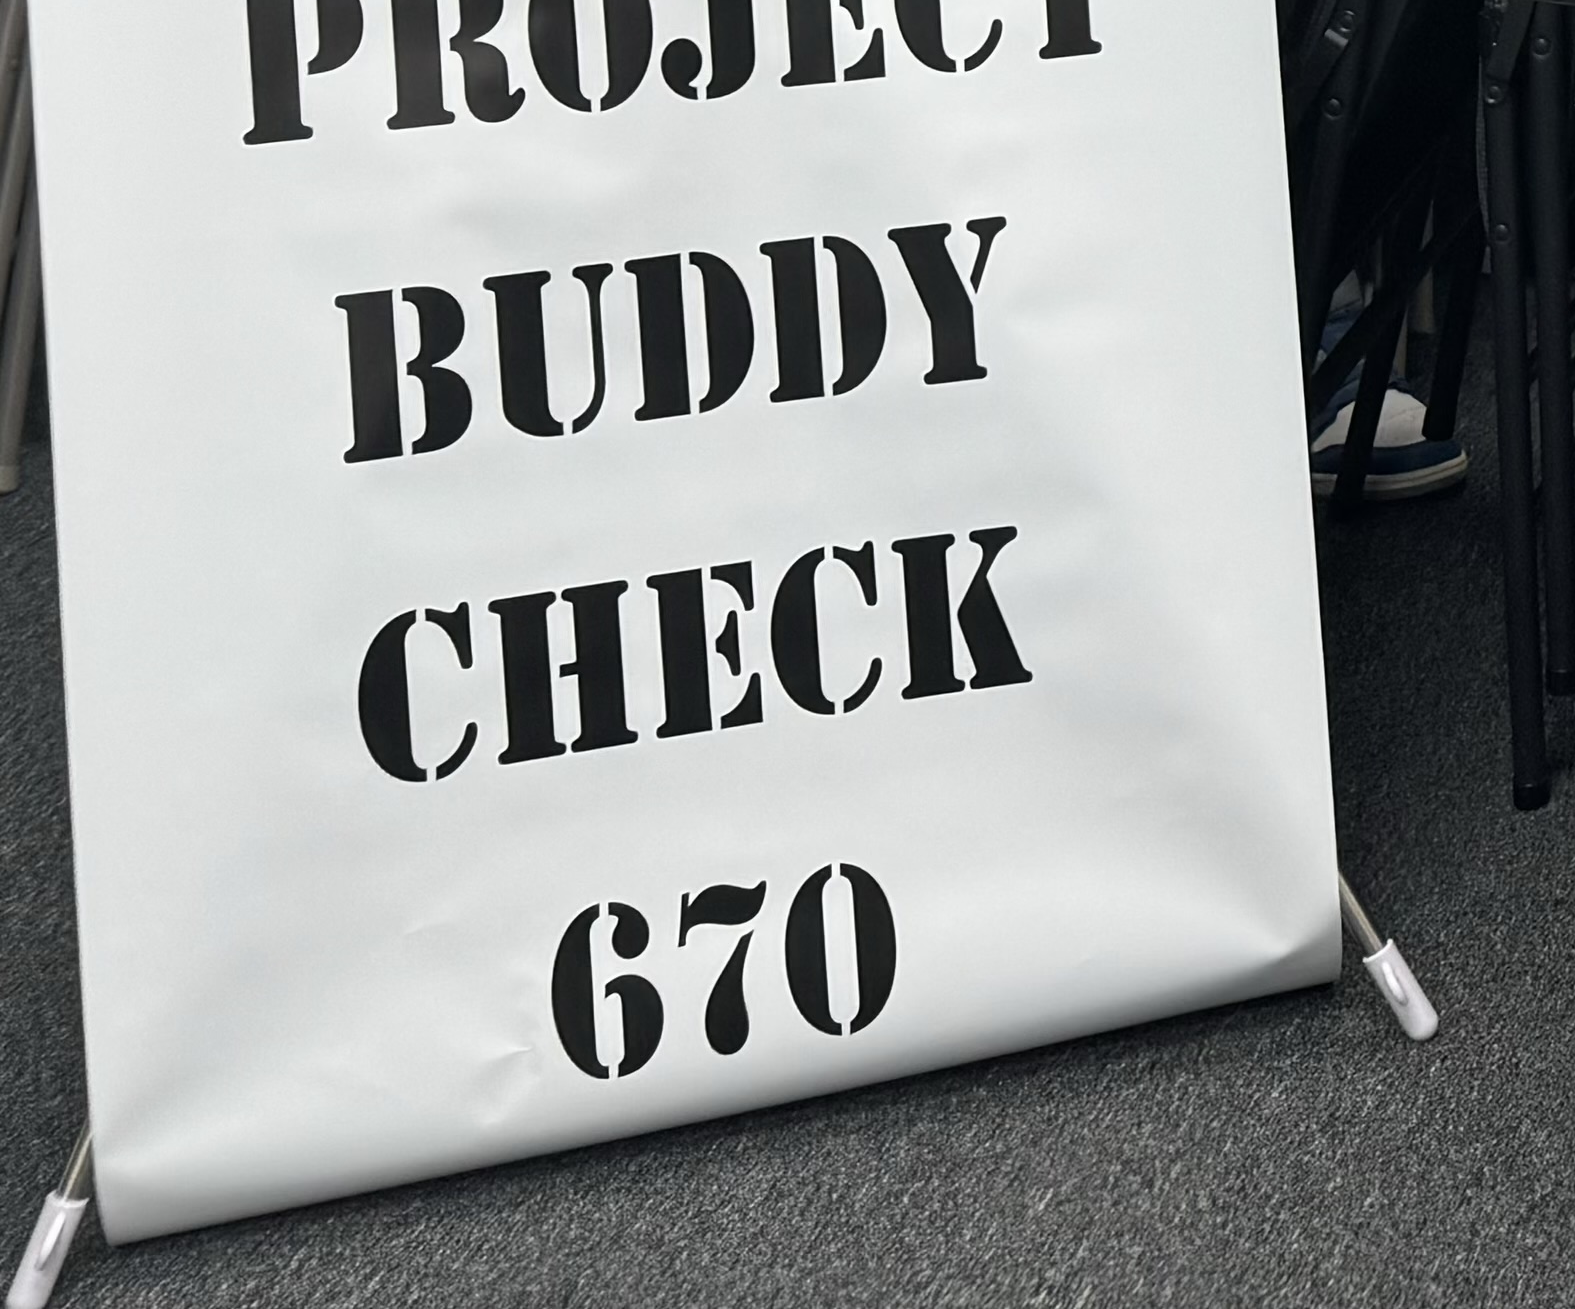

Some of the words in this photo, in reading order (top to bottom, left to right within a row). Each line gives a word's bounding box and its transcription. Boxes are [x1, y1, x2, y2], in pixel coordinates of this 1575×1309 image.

[335, 216, 1007, 464] BUDDY
[357, 525, 1033, 783] CHECK
[550, 862, 897, 1080] 670
